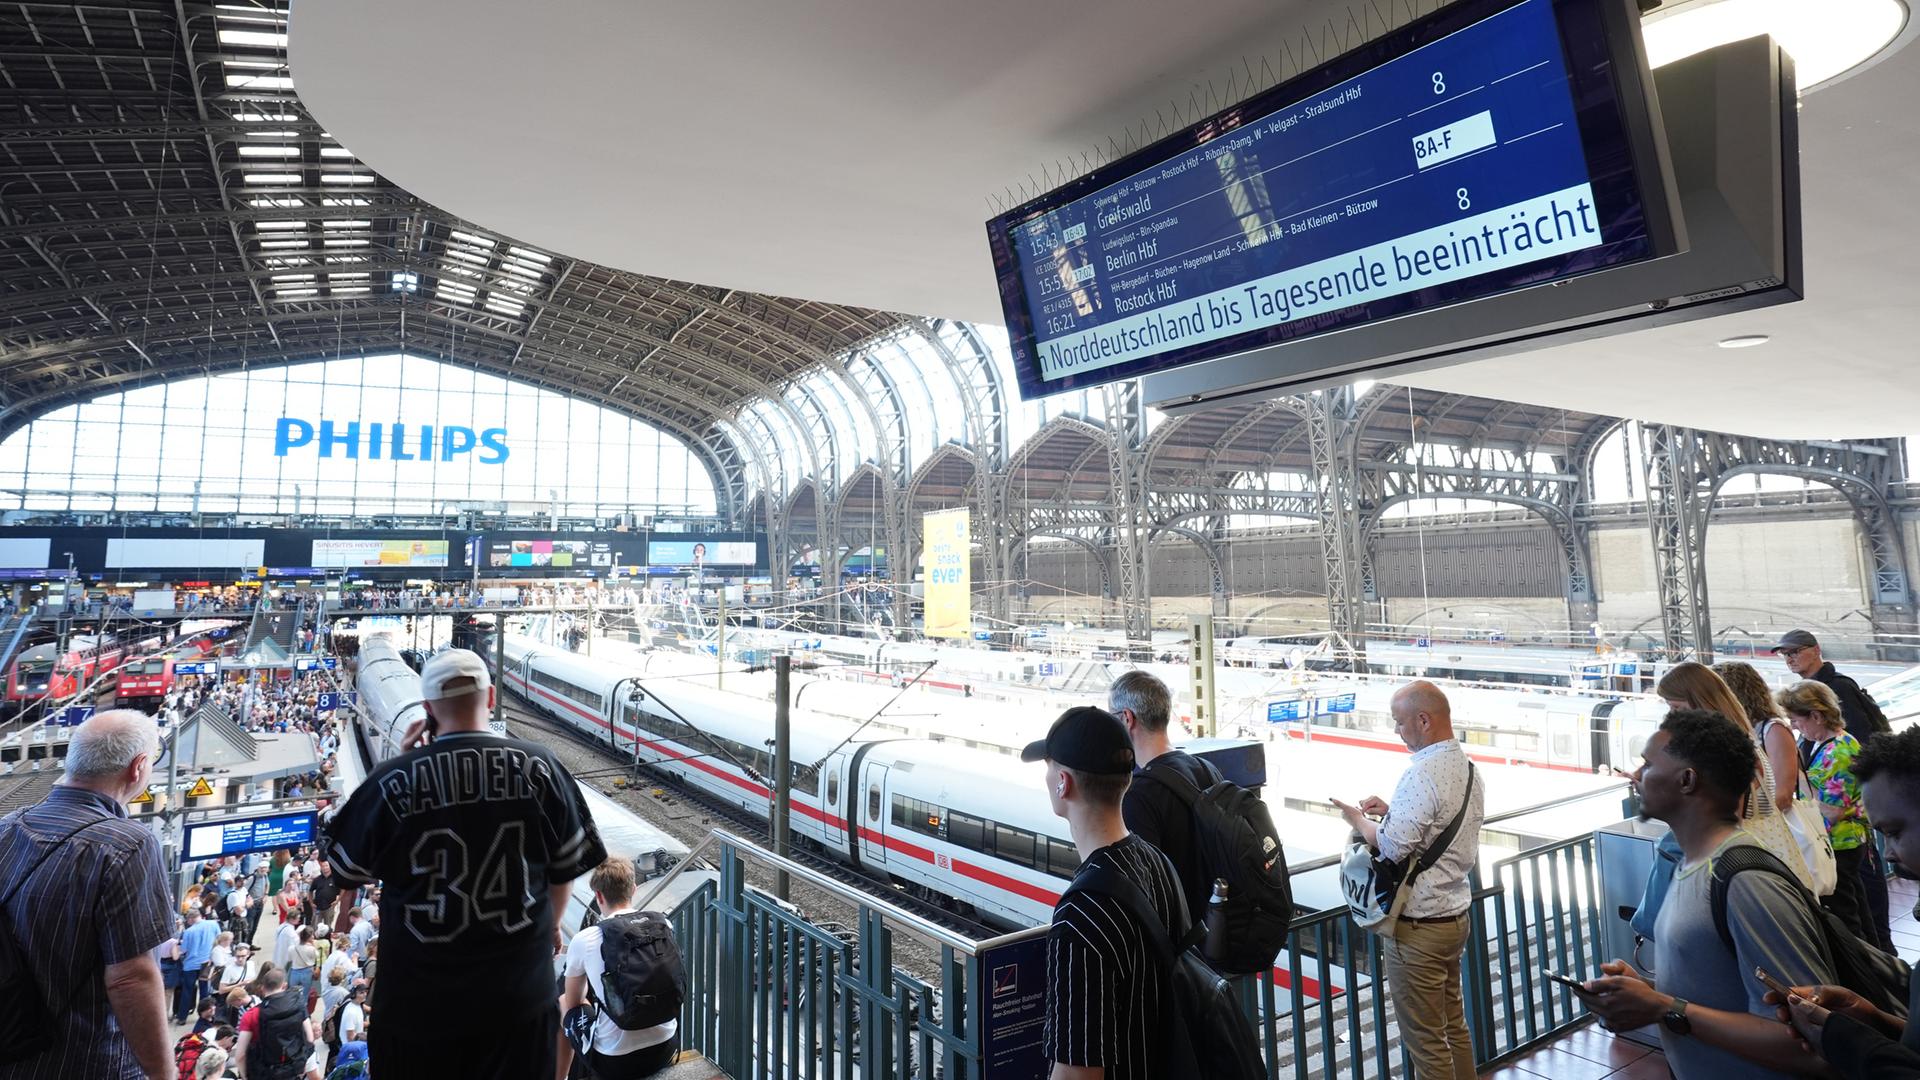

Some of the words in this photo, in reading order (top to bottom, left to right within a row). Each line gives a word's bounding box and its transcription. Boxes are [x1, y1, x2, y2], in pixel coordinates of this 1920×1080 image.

[1432, 72, 1446, 94] 8
[1093, 189, 1118, 209] Schwerin
[1118, 185, 1129, 200] Hbf
[1134, 176, 1157, 193] Bützow
[1162, 163, 1187, 180] Rostock
[1187, 156, 1200, 172] Hbf
[1205, 135, 1254, 161] Ribnitz-Damg.
[1254, 128, 1262, 140] W
[1269, 114, 1298, 134] Velgast
[1305, 95, 1345, 119] Stralsund
[1345, 84, 1363, 103] Hbf
[1415, 129, 1452, 159] 8A-F
[1098, 194, 1152, 229] Greifswald
[1456, 187, 1471, 210] 8
[1030, 232, 1059, 256] 15:43
[1064, 225, 1085, 241] 16:43
[1102, 231, 1135, 251] Ludwigslust
[1140, 216, 1178, 236] Bln-Spandau
[1111, 270, 1150, 293] HH-Bergedorf
[1155, 262, 1178, 279] Büchen
[1183, 252, 1213, 271] Hagenow
[1213, 247, 1231, 263] Land
[1237, 234, 1268, 251] Schwerin
[1269, 225, 1284, 241] Hbf
[1291, 219, 1307, 235] Bad
[1307, 211, 1339, 230] Kleinen
[1346, 198, 1379, 218] Bützow
[1106, 245, 1137, 271] Berlin
[1137, 239, 1158, 260] Hbf
[1050, 295, 1205, 370] Norddeutschland
[1208, 296, 1242, 329] bis
[1244, 254, 1387, 322] Tagesende
[1393, 198, 1596, 282] beeinträcht
[1073, 267, 1093, 282] 17:02
[1114, 288, 1155, 314] Rostock
[1156, 279, 1178, 300] Hbf
[1048, 312, 1076, 335] 16:21
[274, 417, 511, 465] PHILIPS
[932, 568, 963, 584] ever
[81, 708, 92, 721] 7
[320, 694, 330, 707] 8
[379, 747, 553, 823] RAIDERS
[404, 820, 536, 944] 34
